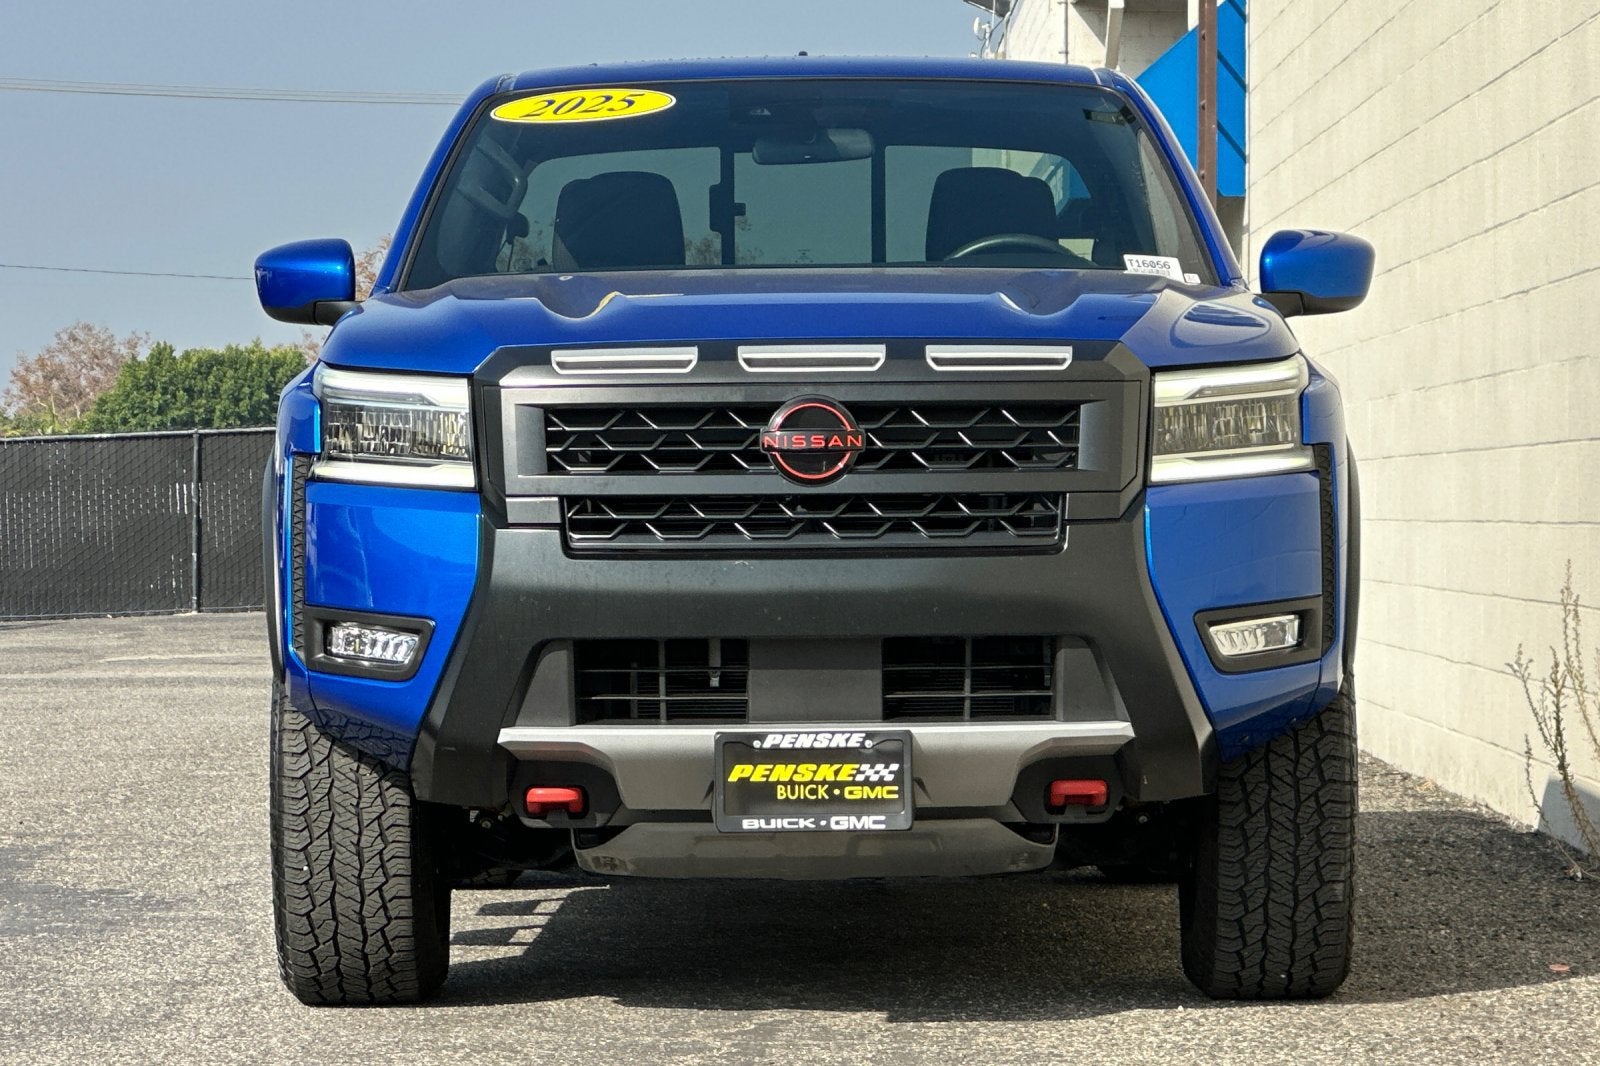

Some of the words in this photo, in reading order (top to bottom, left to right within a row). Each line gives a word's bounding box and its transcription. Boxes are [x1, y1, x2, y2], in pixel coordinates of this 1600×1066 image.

[519, 93, 645, 118] 2025
[1128, 258, 1171, 270] T16056
[763, 434, 863, 448] NISSAN
[762, 733, 866, 748] PENSKE
[727, 764, 861, 782] PENSKE
[776, 784, 829, 799] BUICK
[844, 786, 899, 799] GMC
[742, 818, 816, 829] BUICK
[830, 816, 886, 830] GMC
